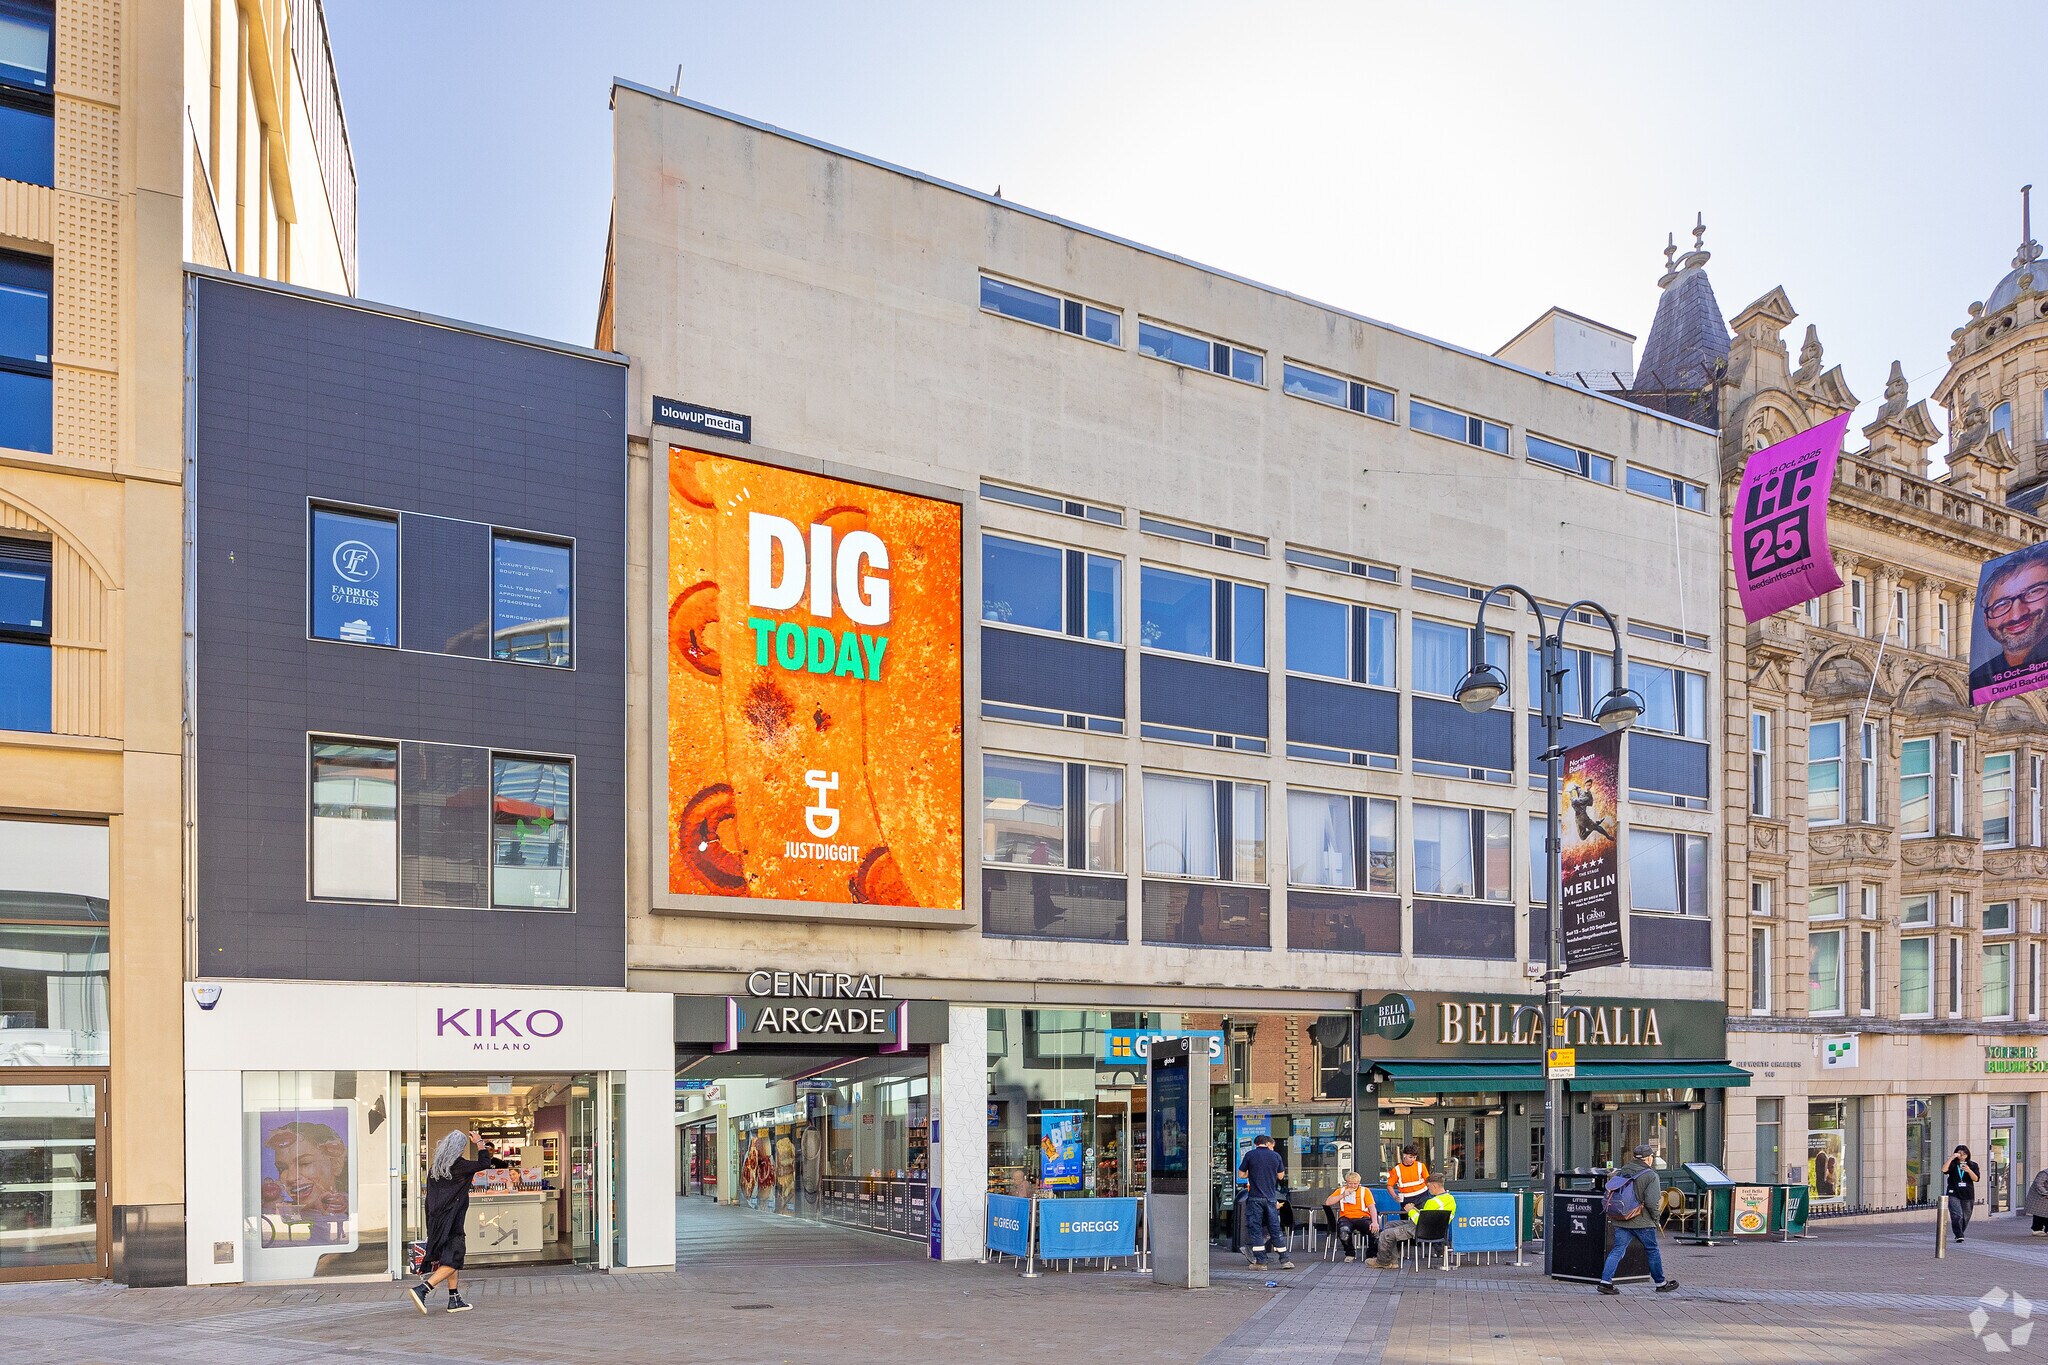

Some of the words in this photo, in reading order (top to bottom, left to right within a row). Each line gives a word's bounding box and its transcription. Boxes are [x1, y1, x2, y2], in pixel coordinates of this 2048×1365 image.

[661, 405, 741, 432] blowUPmedia
[1797, 448, 1822, 464] 2025
[1750, 515, 1802, 573] 25
[499, 561, 523, 569] LUXURY
[523, 565, 554, 574] CLOTHING
[499, 568, 530, 577] BOUTIQUE
[749, 512, 890, 626] DIG
[331, 584, 380, 599] FABRICS
[498, 591, 541, 600] APPOINTMENT
[345, 596, 379, 607] LEEDS
[748, 617, 889, 682] TODAY
[1992, 672, 2003, 682] 16
[1992, 679, 2018, 695] David
[1569, 752, 1595, 767] Northern
[1568, 762, 1586, 774] Ballet
[783, 840, 860, 863] JUSTDIGGIT
[1586, 867, 1599, 876] STAGE
[1563, 873, 1615, 898] MERLIN
[1595, 921, 1618, 930] September
[746, 969, 894, 999] CENTRAL
[1378, 1003, 1405, 1016] BELLA
[437, 1007, 564, 1038] KIKO
[754, 1006, 886, 1034] ARCADE
[1378, 1013, 1406, 1027] ITALIA
[473, 1043, 531, 1051] MILANO
[706, 1086, 720, 1100] Nails
[1318, 1121, 1335, 1129] ZERO
[998, 1217, 1020, 1231] GREGGS
[1071, 1219, 1119, 1233] GREGGS
[1469, 1215, 1511, 1228] GREGGS
